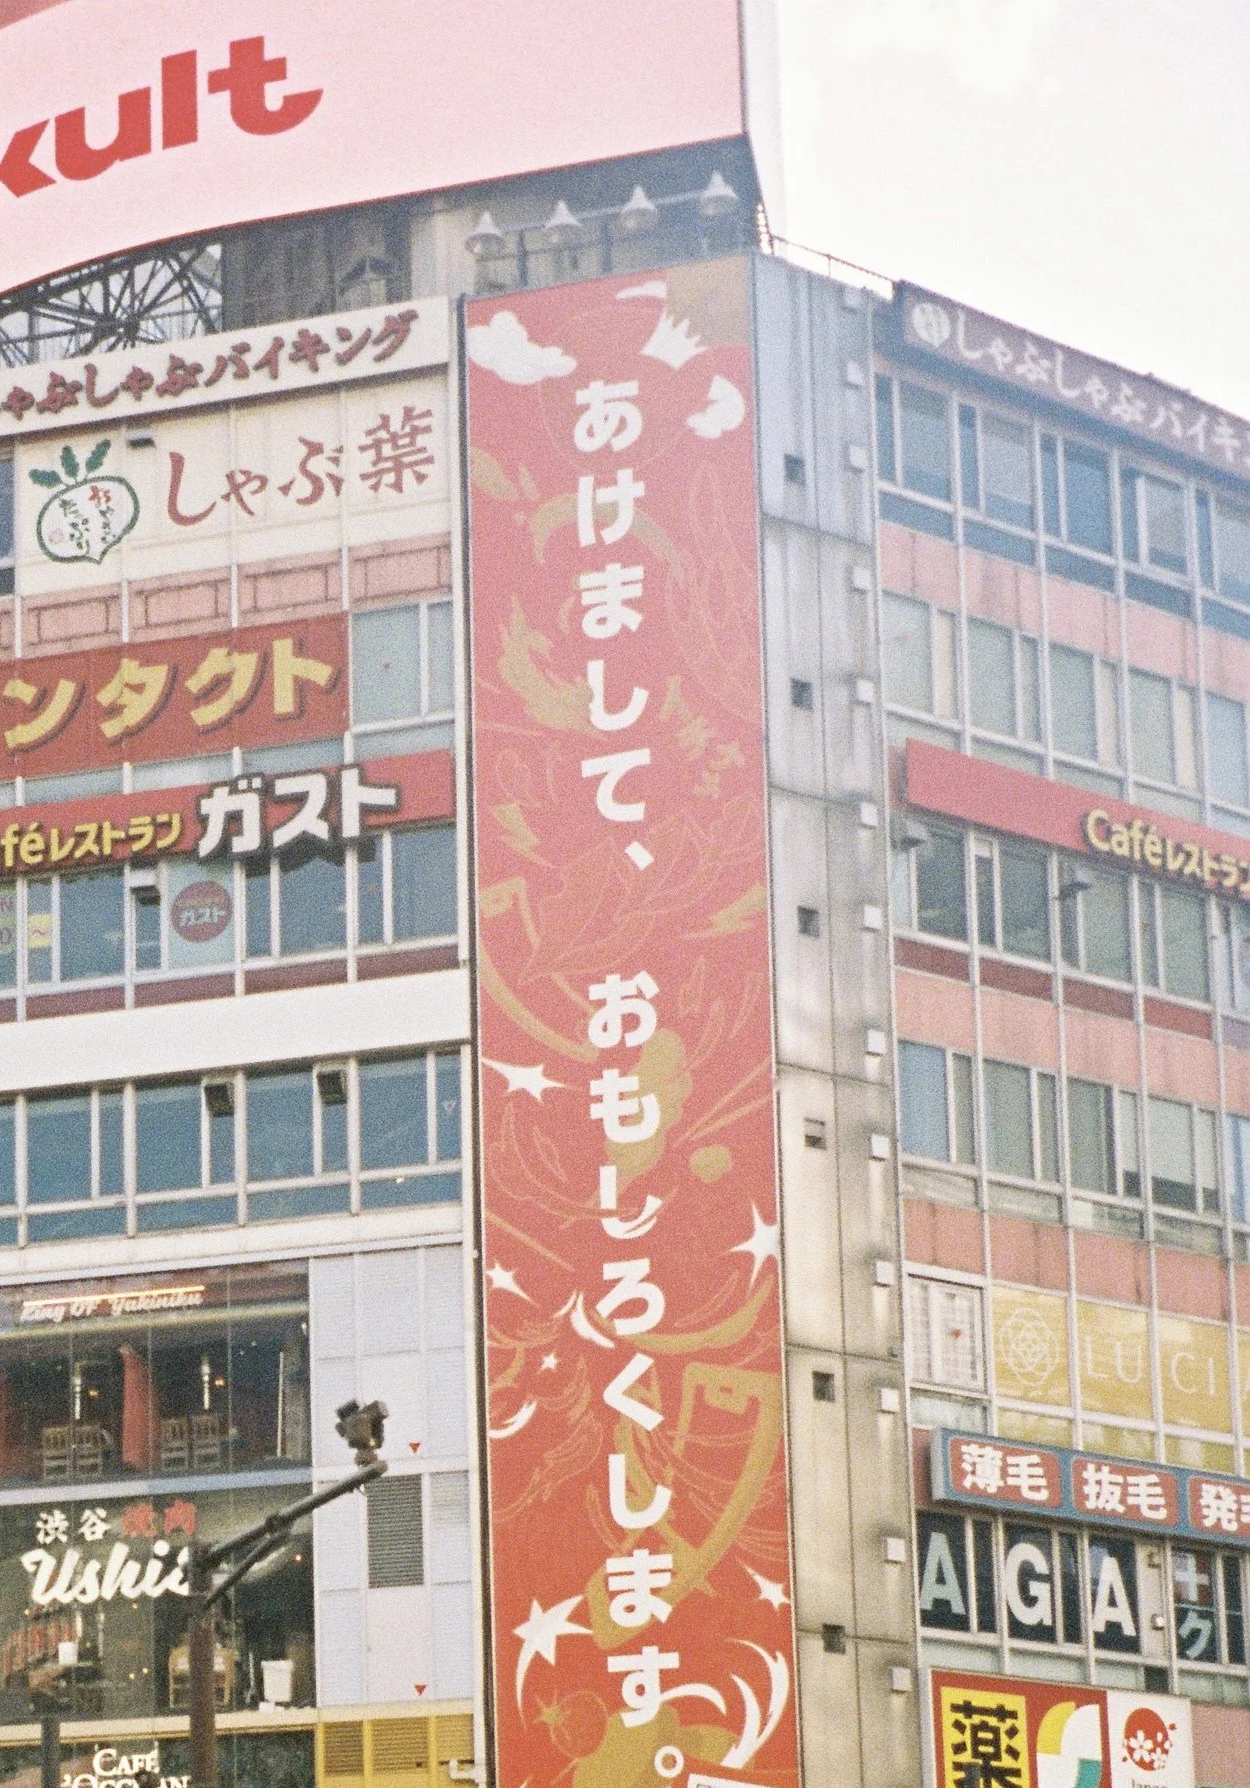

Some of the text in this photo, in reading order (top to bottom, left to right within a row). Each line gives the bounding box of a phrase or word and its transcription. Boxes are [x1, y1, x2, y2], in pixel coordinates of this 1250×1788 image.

[957, 309, 1250, 466] しゃぶしゃぶバイキ
[165, 406, 437, 528] しゃぶ葉
[198, 767, 398, 859] ガスト
[1083, 1331, 1250, 1400] LUCI
[960, 1443, 1050, 1502] 薄毛
[1081, 1464, 1168, 1521] 抜毛
[1199, 1483, 1250, 1532] 発
[920, 1531, 1137, 1638] AGA
